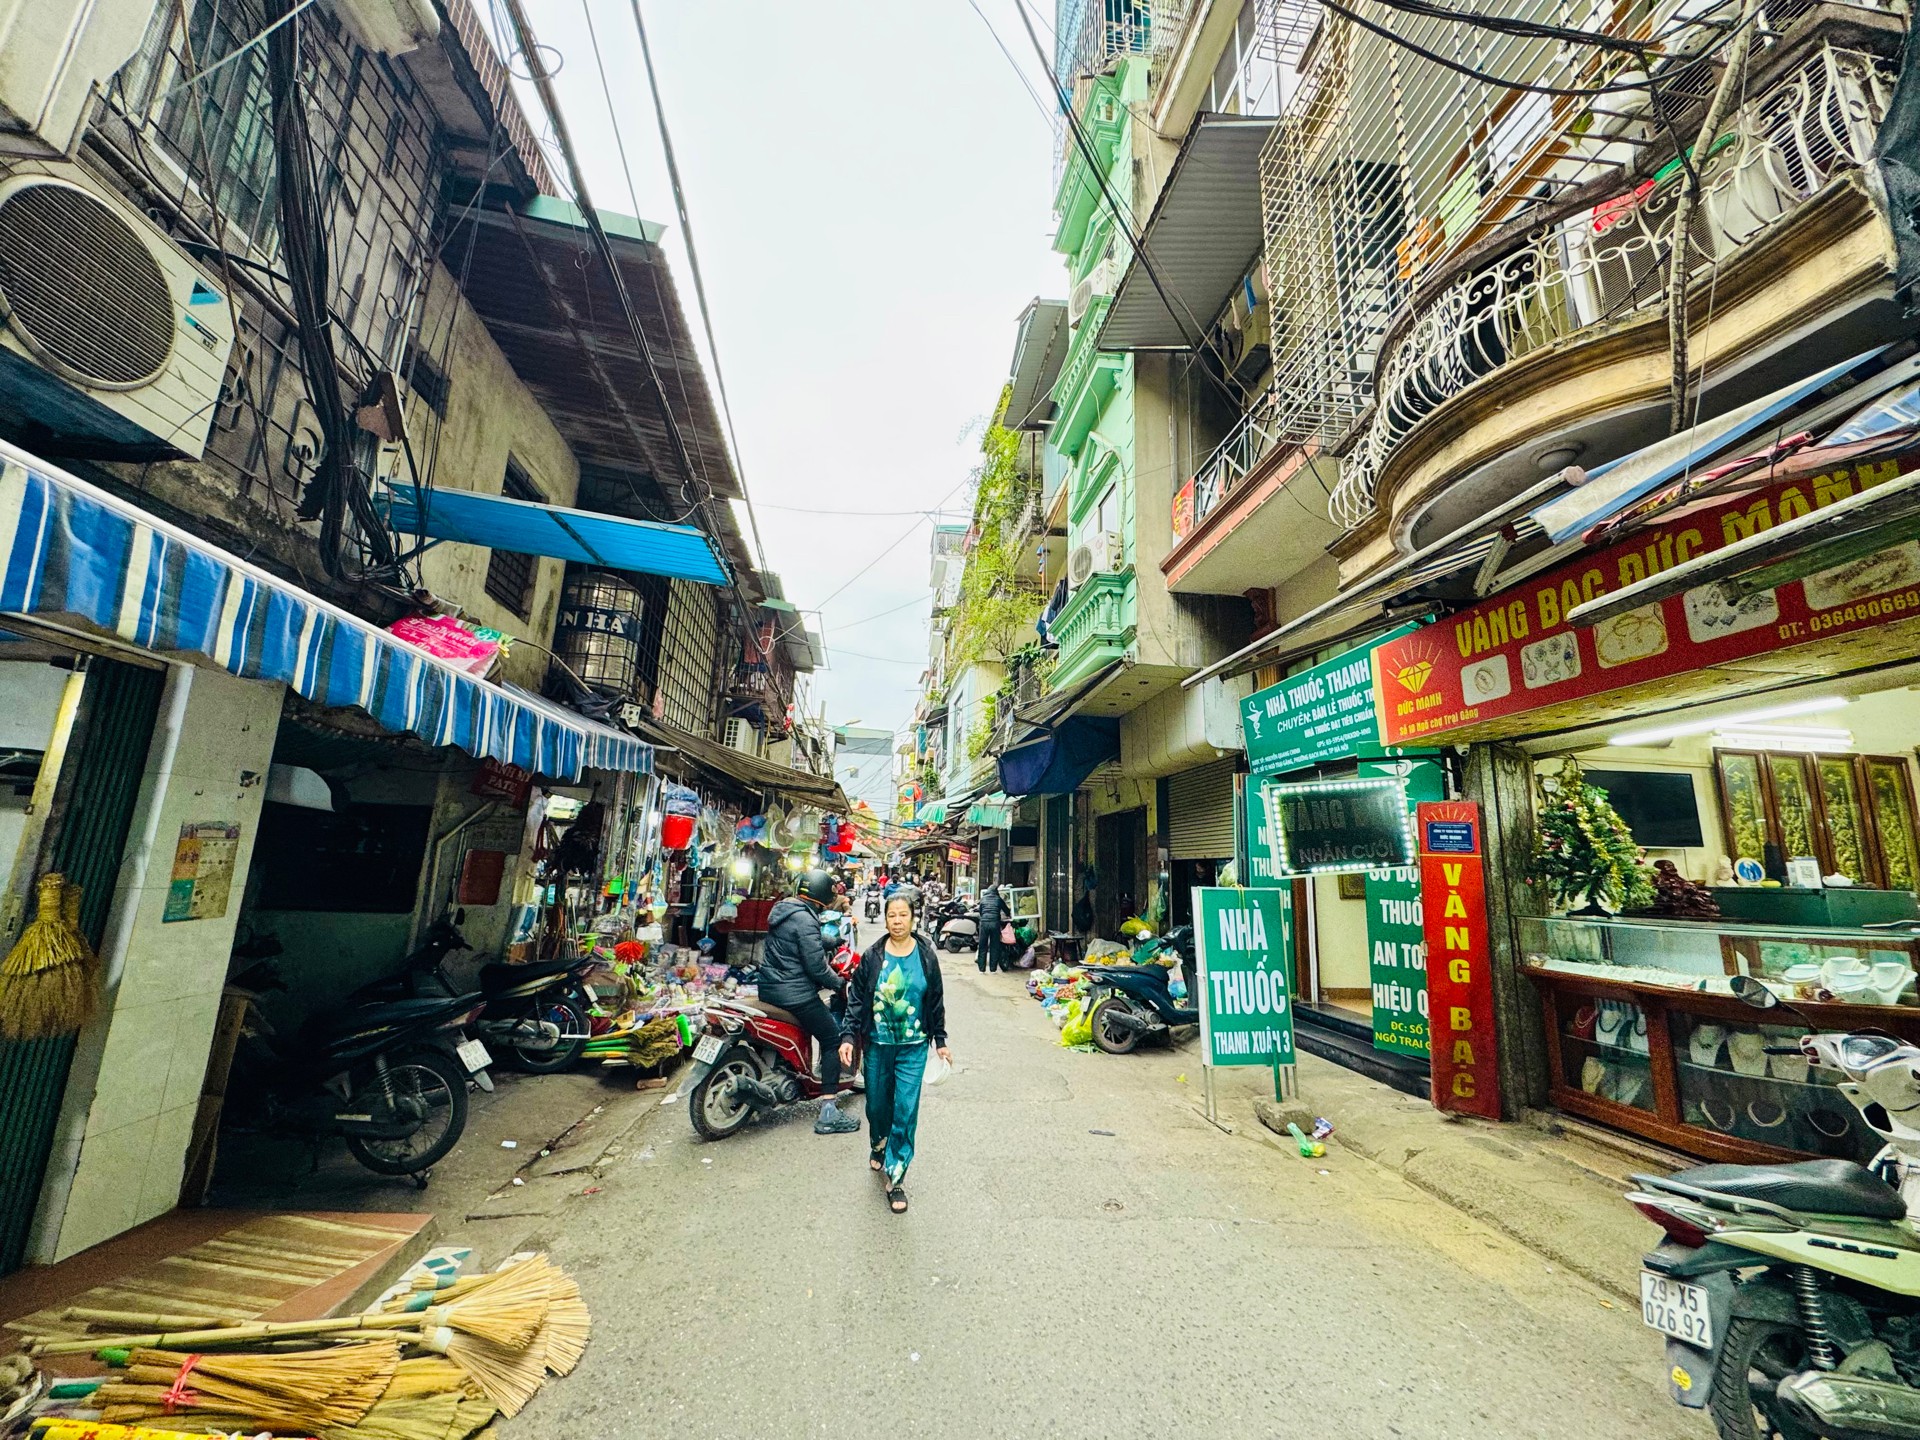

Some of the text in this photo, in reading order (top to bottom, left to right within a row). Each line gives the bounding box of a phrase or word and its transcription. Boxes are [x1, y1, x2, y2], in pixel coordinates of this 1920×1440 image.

[1455, 599, 1529, 658] VÀNG
[1265, 658, 1370, 719] NHÀ THUỐC THANH
[1397, 691, 1442, 716] ĐỨC MẠNH
[1277, 708, 1312, 733] CHUYÊN:
[1311, 703, 1328, 722] BÁN
[1337, 689, 1363, 713] THUỐC
[1218, 899, 1268, 951] NHÀ
[1442, 862, 1471, 985] VÀNG
[1373, 940, 1397, 967] AN
[1210, 955, 1286, 1015] THUỐC
[1372, 980, 1412, 1017] HIỆU
[1214, 1031, 1250, 1055] THANH
[1282, 1031, 1291, 1054] 3
[1375, 1031, 1397, 1043] NGÕ
[1399, 1035, 1423, 1050] TRẠI
[1390, 1021, 1407, 1033] ĐC:
[1409, 1022, 1423, 1035] SỐ
[1450, 1008, 1476, 1099] BẠC
[1648, 1276, 1698, 1313] 29-X5
[1645, 1301, 1707, 1344] 026.92
